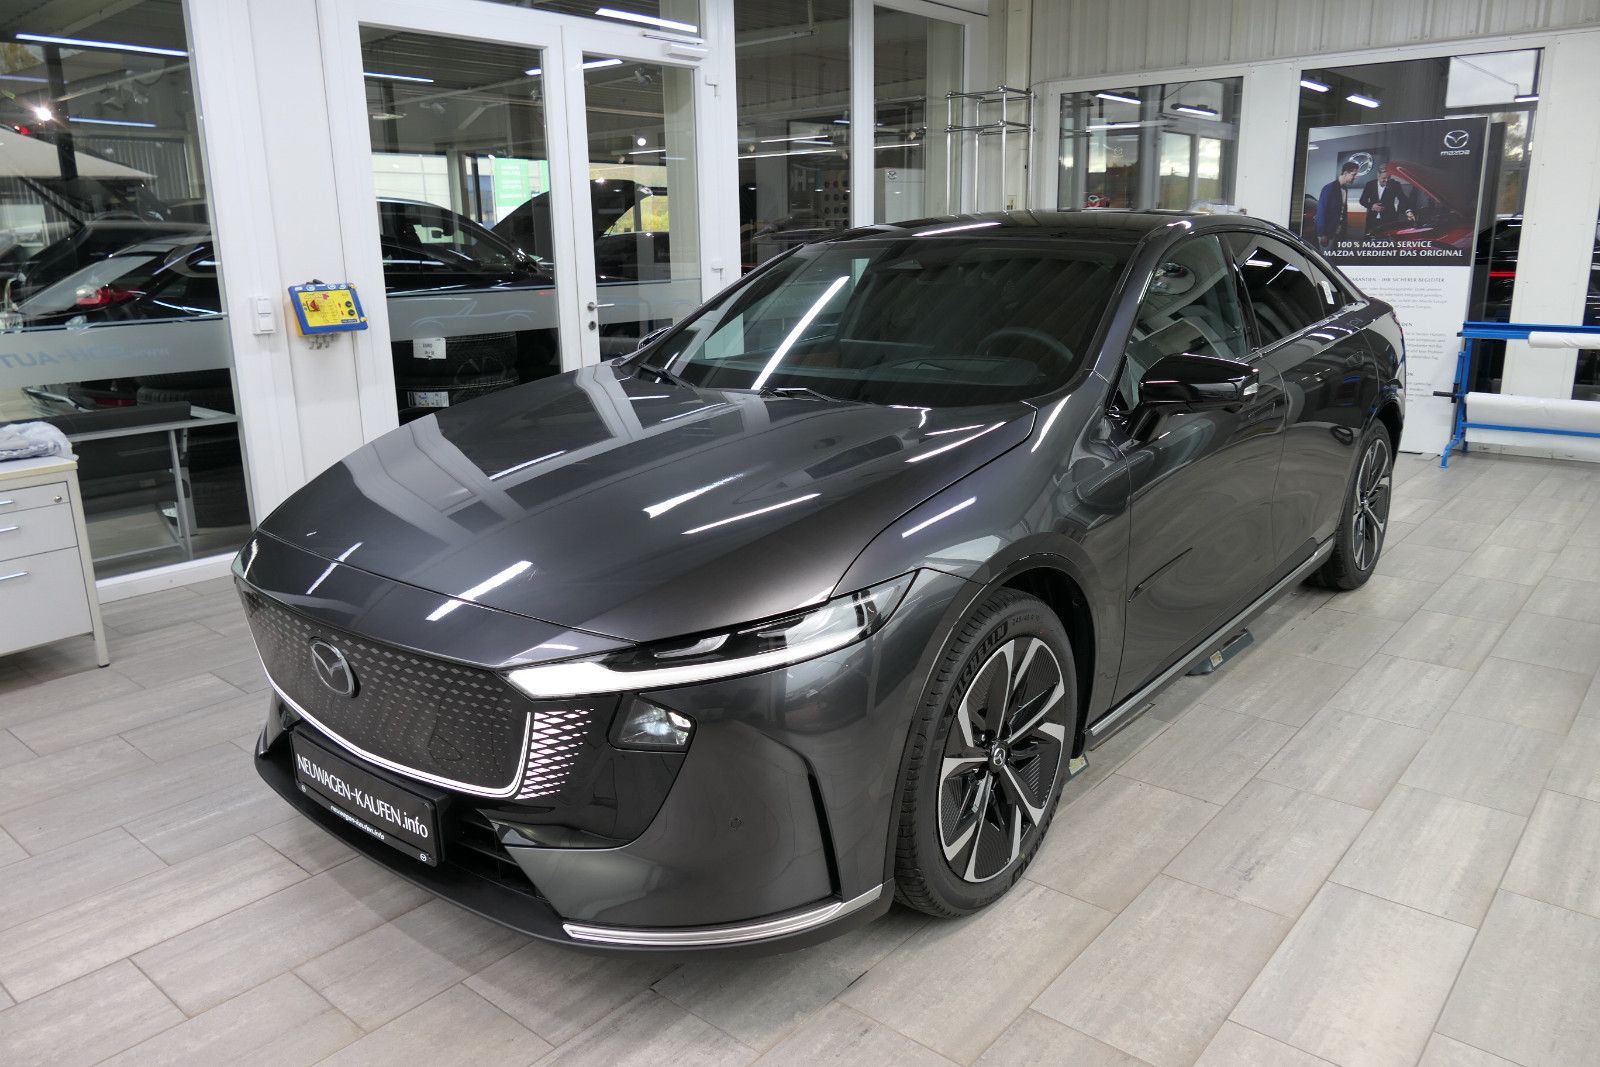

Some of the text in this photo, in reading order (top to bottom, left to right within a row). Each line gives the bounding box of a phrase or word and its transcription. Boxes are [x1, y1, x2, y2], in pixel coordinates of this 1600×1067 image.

[1397, 240, 1433, 248] SERVICE
[1399, 249, 1418, 257] DAS
[1419, 249, 1463, 257] ORIGINAL
[297, 753, 429, 838] NEUWAGEN-KAUFEN.info
